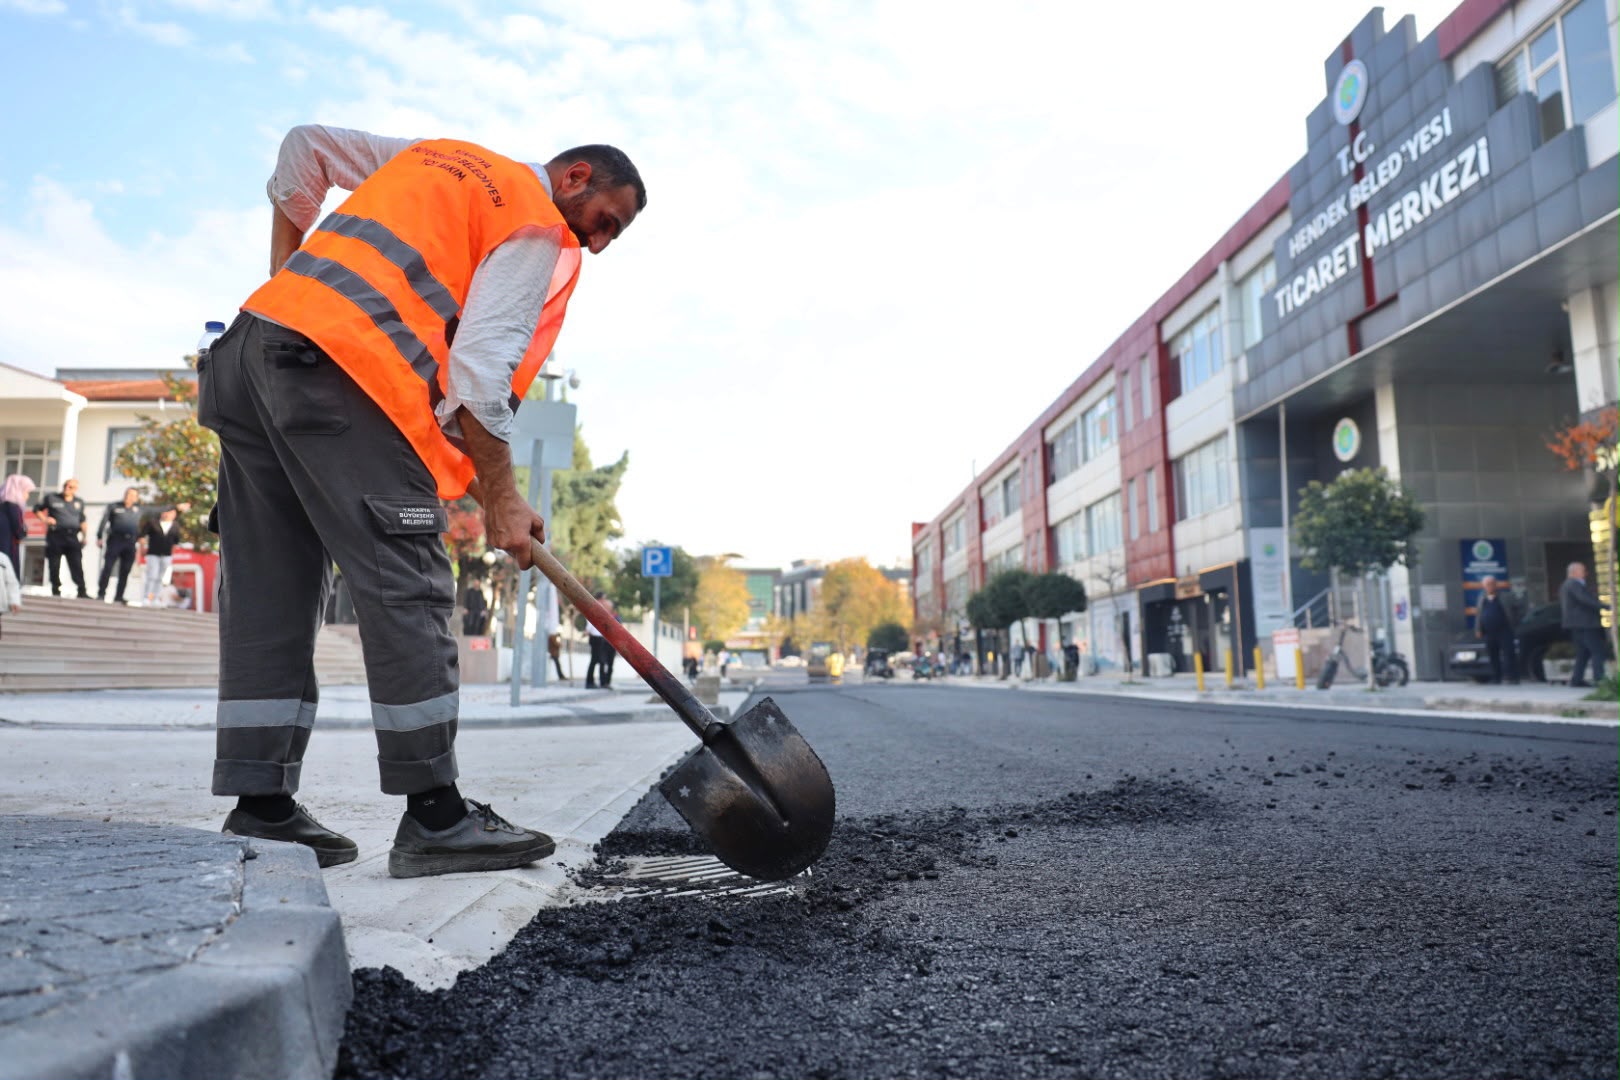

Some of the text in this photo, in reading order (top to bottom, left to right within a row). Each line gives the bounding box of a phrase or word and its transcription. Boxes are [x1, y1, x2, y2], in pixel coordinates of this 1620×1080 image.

[1289, 106, 1453, 259] HENDEK BELEDYESİ
[1336, 129, 1375, 177] T.C.
[1364, 135, 1490, 258] MERKEZİ
[646, 549, 664, 574] P
